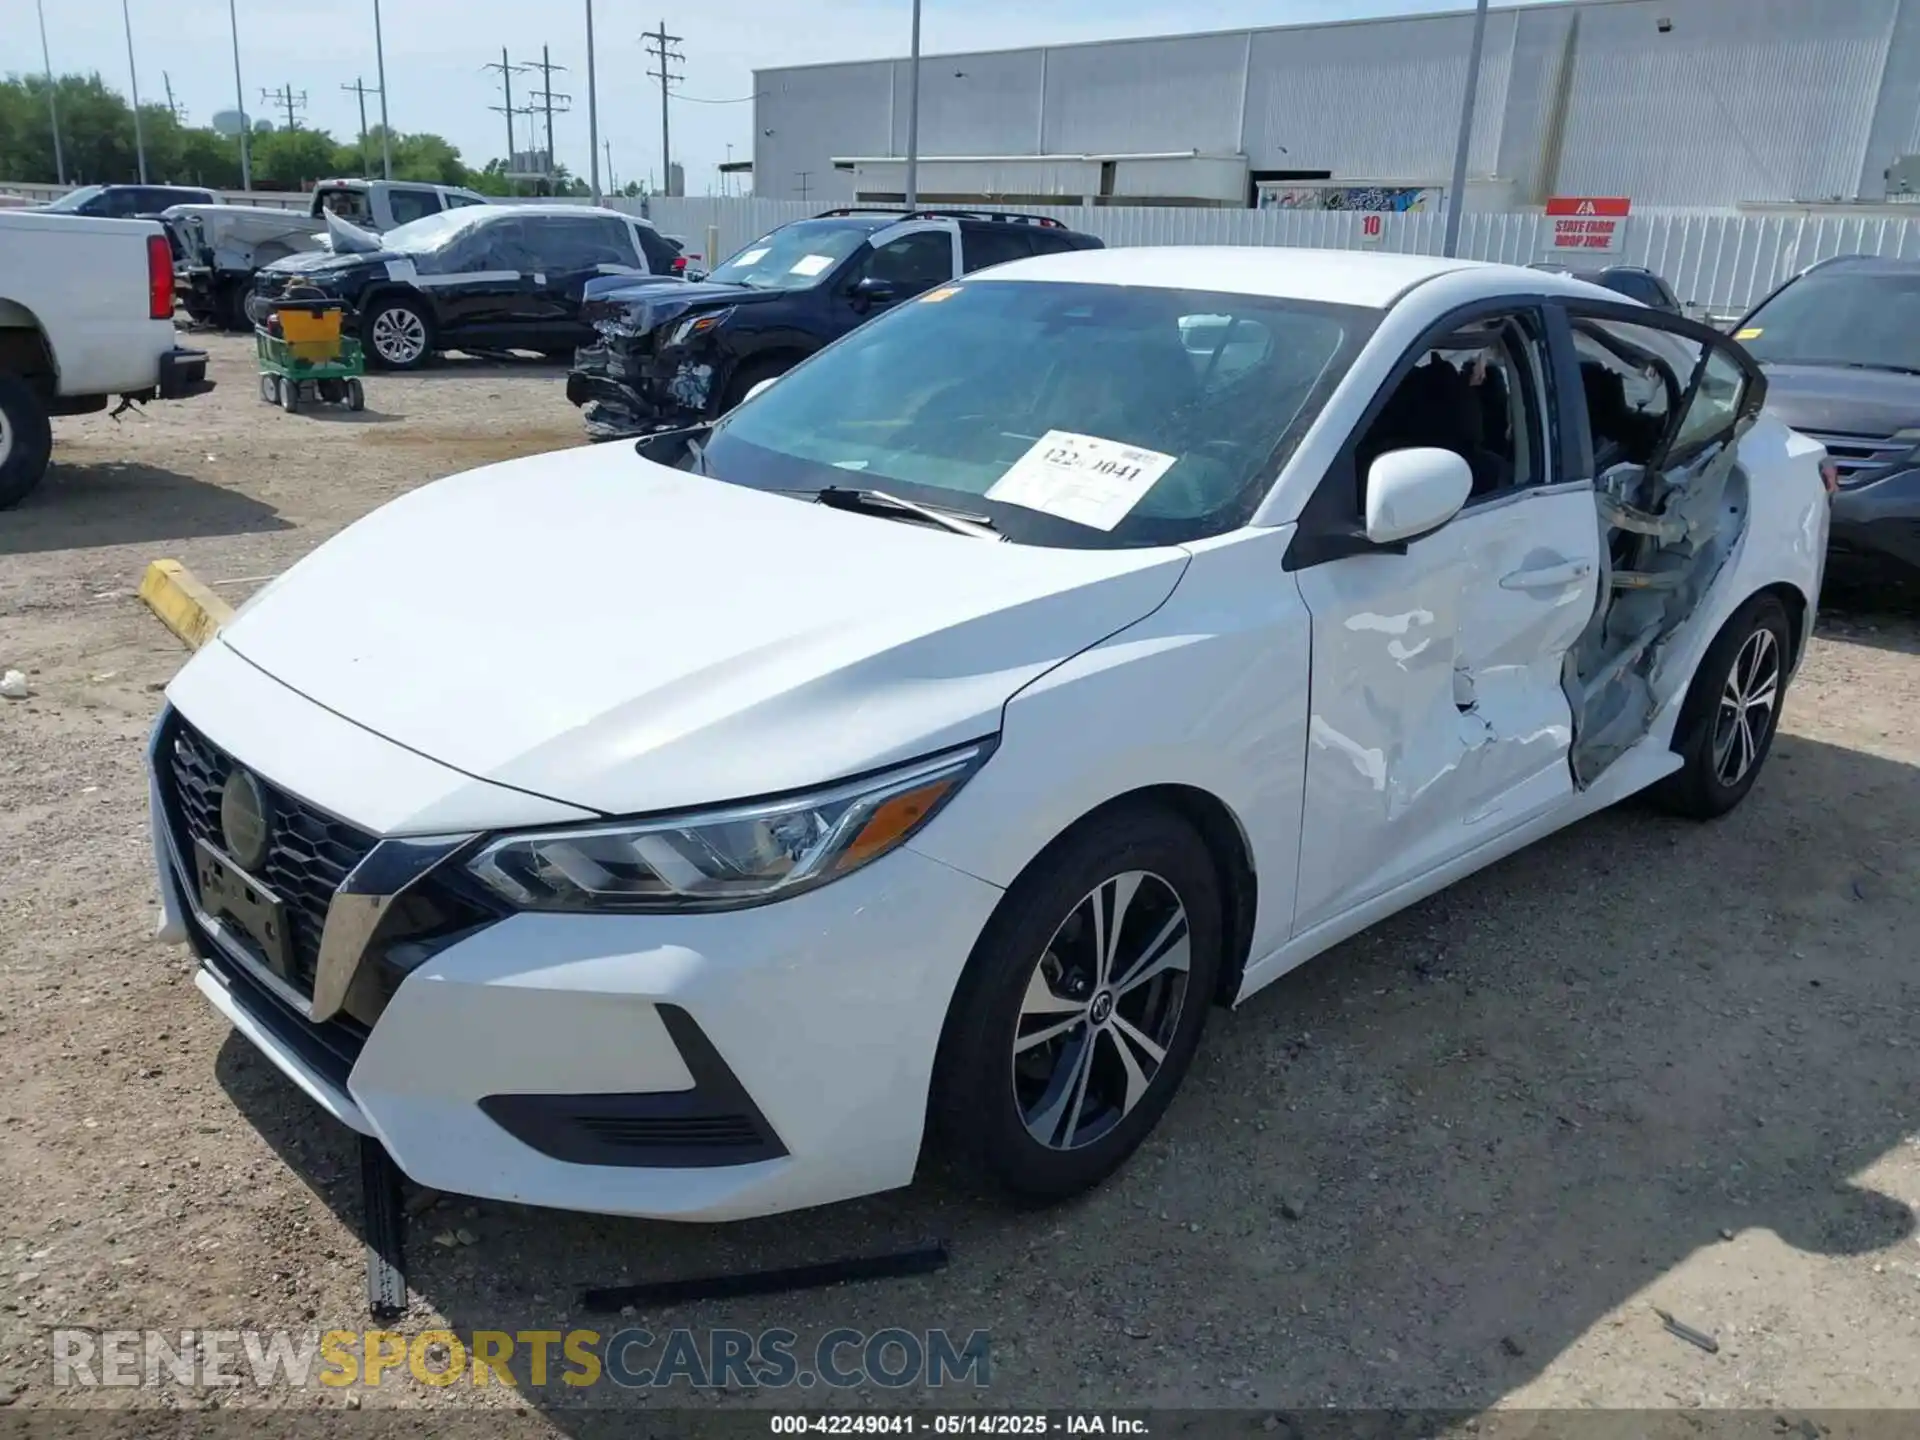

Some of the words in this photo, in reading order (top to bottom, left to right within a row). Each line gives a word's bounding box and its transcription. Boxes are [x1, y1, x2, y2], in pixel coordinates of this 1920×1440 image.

[1363, 215, 1381, 235] 10
[1555, 220, 1587, 233] STATE
[1585, 220, 1616, 233] FARM
[1554, 235, 1583, 248] DROP
[1582, 235, 1613, 248] ZONE
